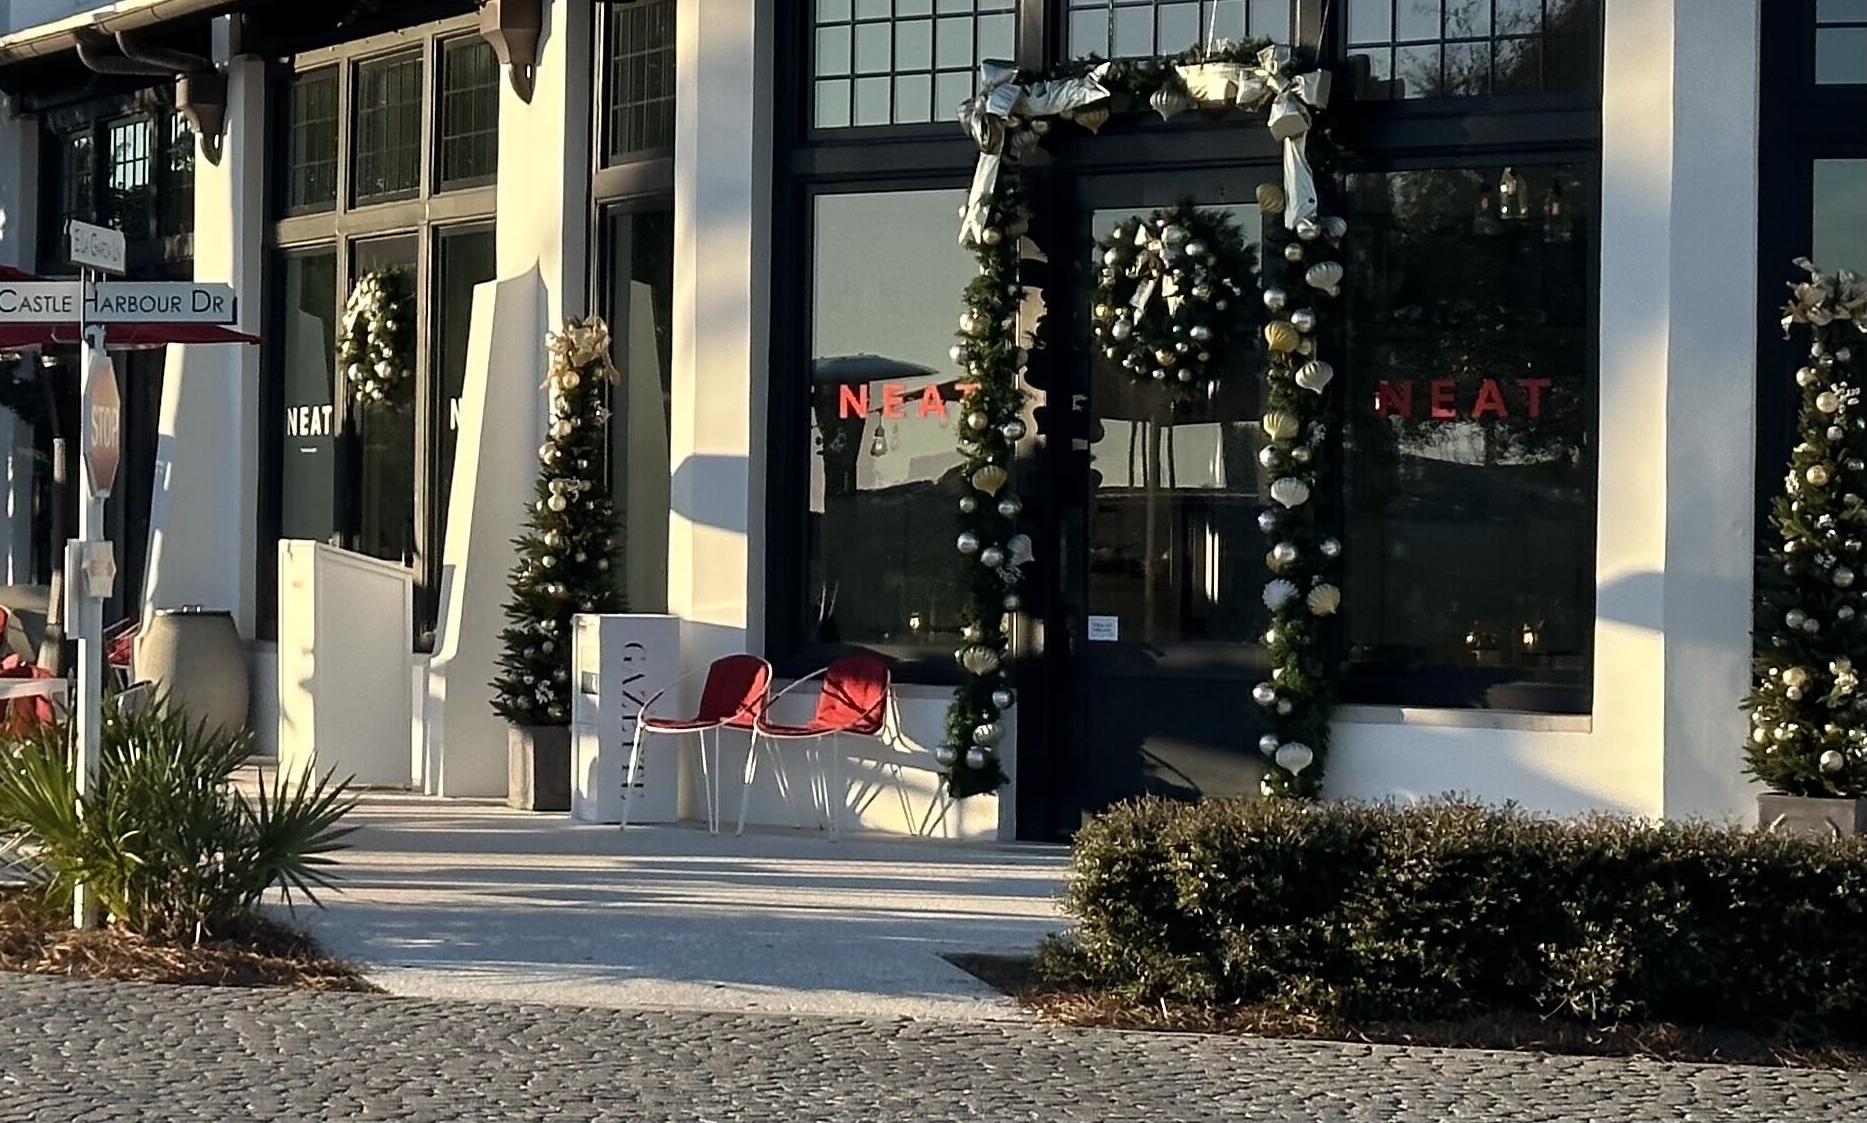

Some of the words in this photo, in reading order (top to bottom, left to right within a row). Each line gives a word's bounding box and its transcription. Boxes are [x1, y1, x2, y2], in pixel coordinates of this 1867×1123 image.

[1377, 379, 1551, 418] NEAT
[91, 406, 120, 446] STOP
[287, 405, 332, 436] NEAT
